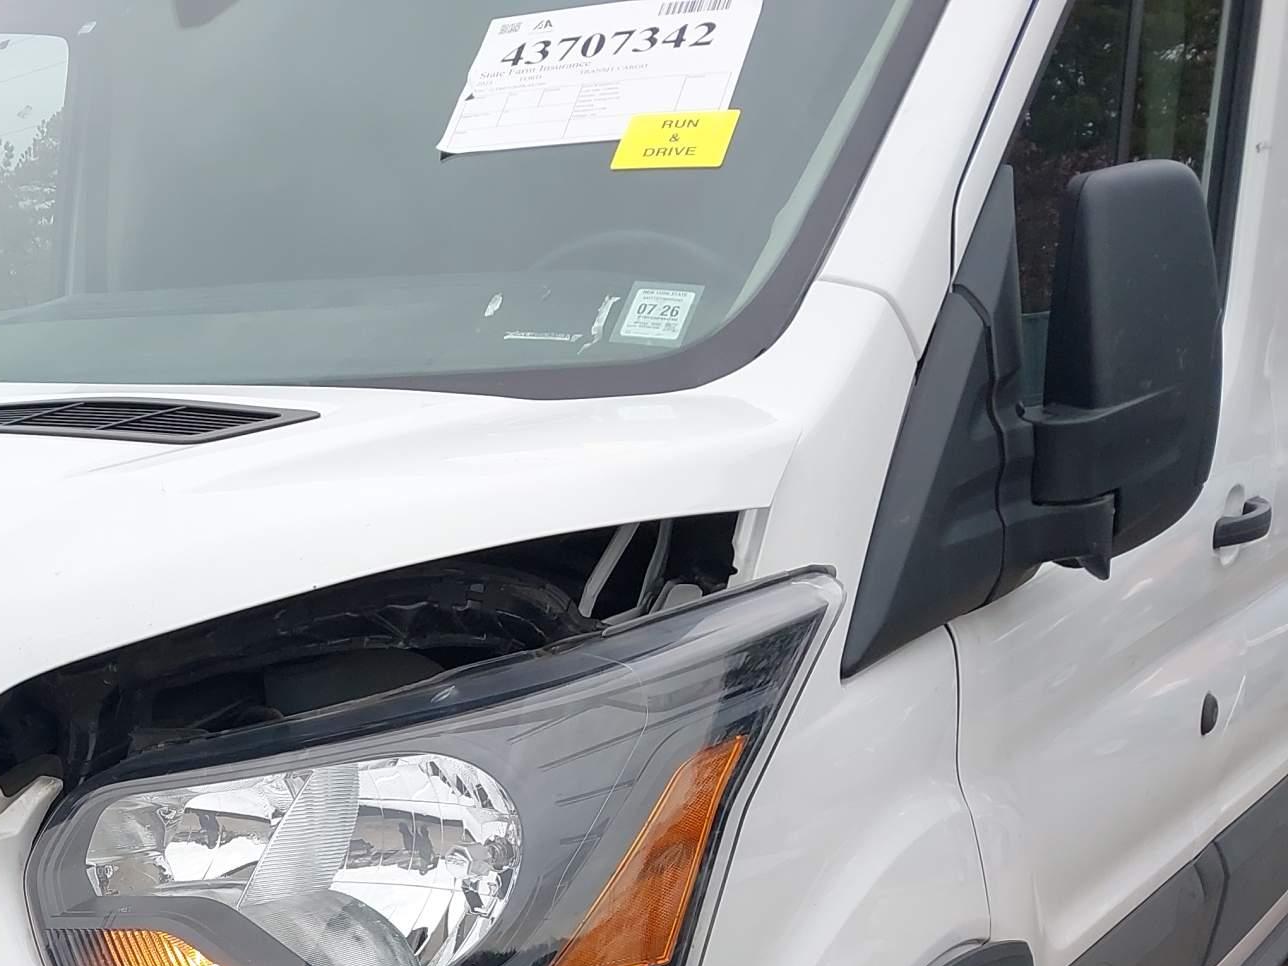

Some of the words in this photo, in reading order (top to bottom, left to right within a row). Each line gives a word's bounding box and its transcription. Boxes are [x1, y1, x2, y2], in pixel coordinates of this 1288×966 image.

[500, 21, 717, 67] 43707342
[661, 119, 700, 129] RUN
[669, 133, 680, 143] &
[642, 146, 697, 158] DRIVE
[636, 303, 658, 315] 07
[660, 304, 681, 317] 26
